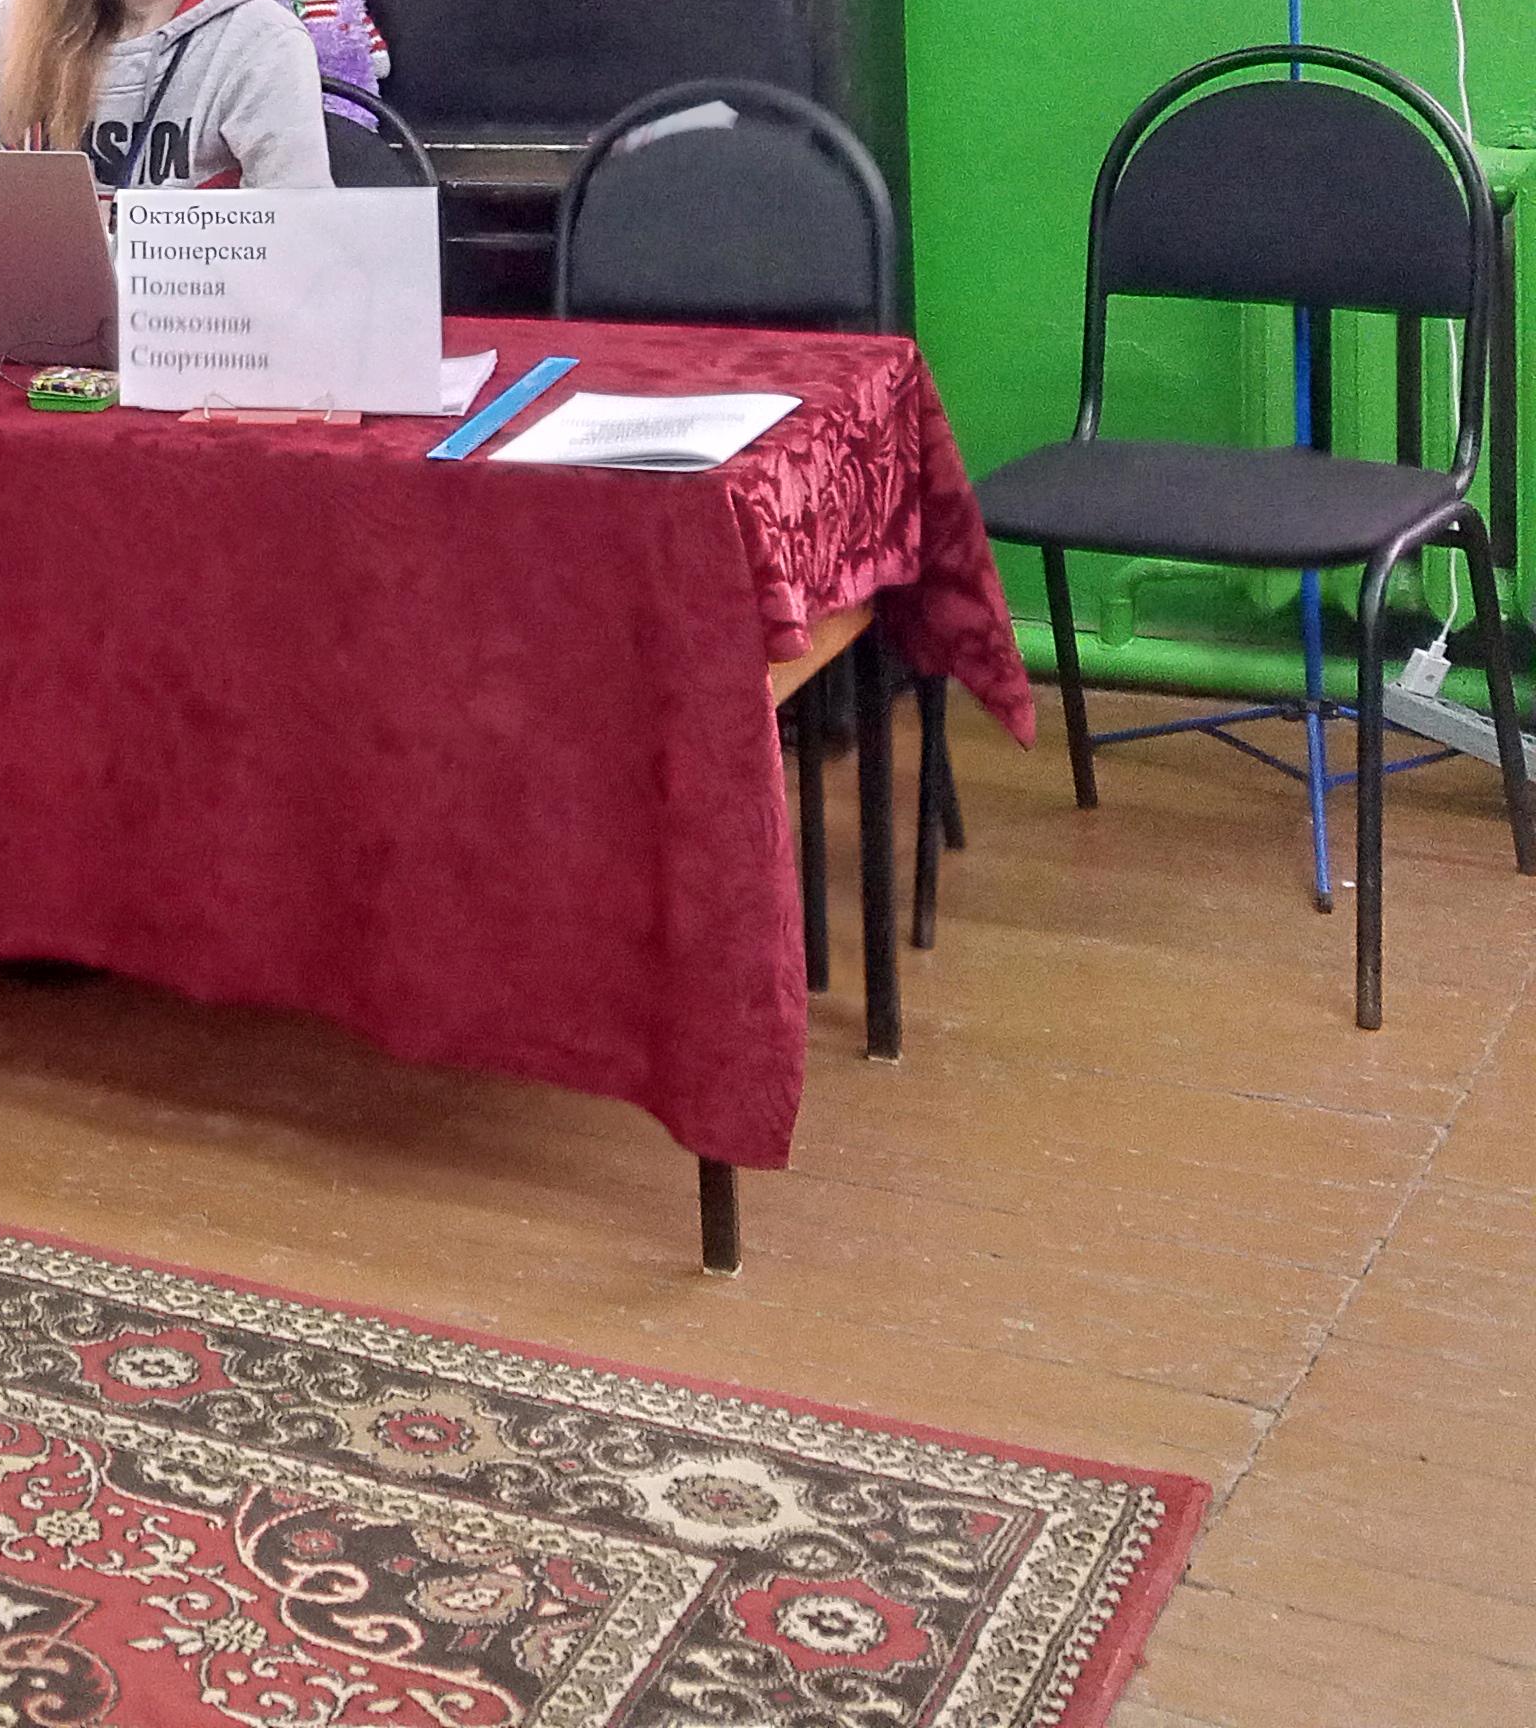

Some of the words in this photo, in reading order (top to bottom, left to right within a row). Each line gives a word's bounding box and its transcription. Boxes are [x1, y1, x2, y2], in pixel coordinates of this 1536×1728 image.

[129, 204, 276, 230] Октябрьская
[130, 240, 267, 265] Пионерская
[130, 275, 226, 296] Полевая
[130, 309, 252, 334] Совхозная
[131, 344, 269, 374] Спортивная
